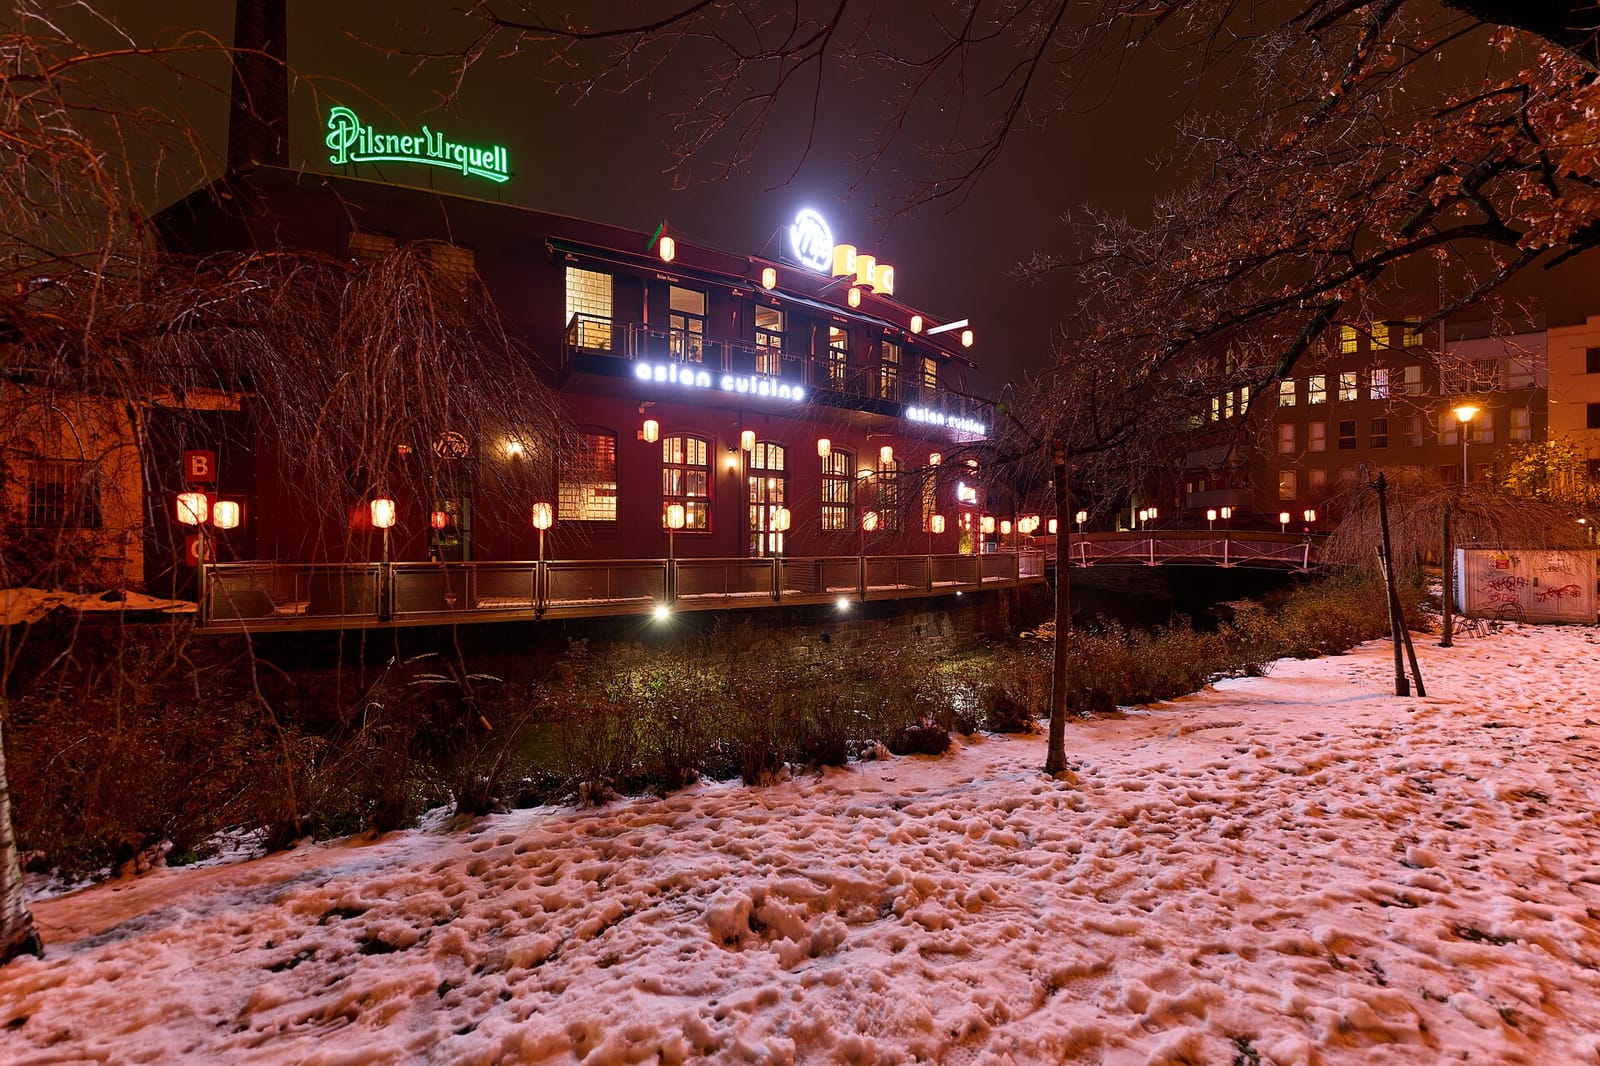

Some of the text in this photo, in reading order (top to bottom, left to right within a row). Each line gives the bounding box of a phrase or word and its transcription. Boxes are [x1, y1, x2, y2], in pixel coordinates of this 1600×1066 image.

[326, 106, 509, 176] Pilsner Urquell
[635, 363, 804, 400] asian cuisine
[191, 455, 208, 476] B
